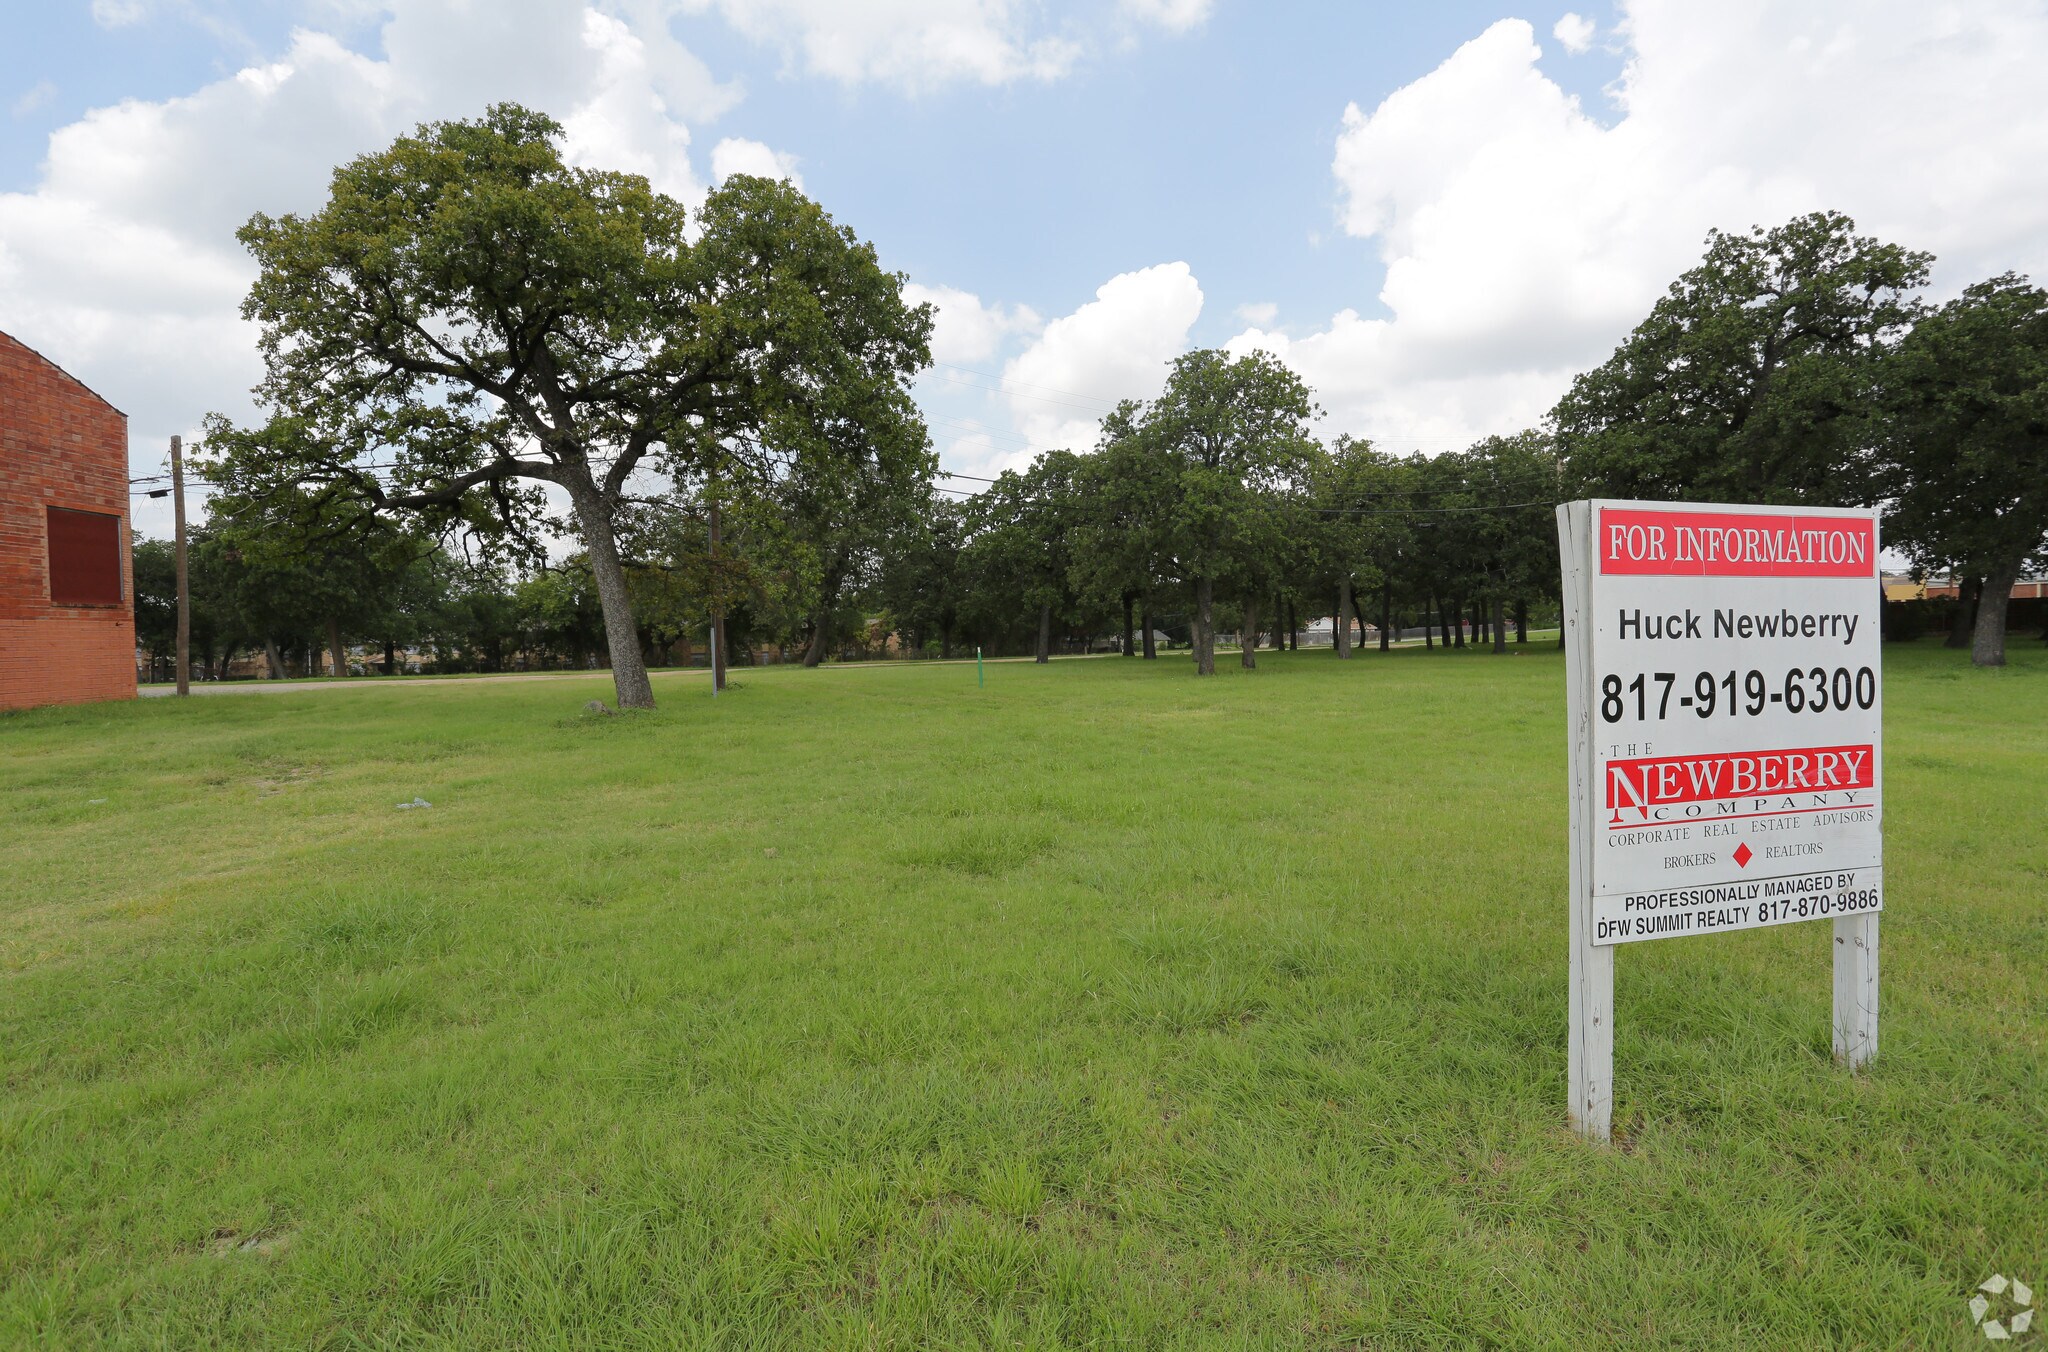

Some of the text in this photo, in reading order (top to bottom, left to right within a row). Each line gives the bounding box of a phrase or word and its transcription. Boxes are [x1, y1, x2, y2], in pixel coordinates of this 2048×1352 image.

[1608, 524, 1866, 564] FOR INFORMATION
[1620, 608, 1858, 645] Huck Newberry
[1602, 666, 1875, 723] 817-919-6300
[1611, 743, 1653, 757] THE
[1609, 750, 1867, 823] NEWBERRY
[1654, 792, 1859, 820] COMPANY
[1608, 810, 1874, 847] CORPORATE REAL ESTATE ADVISORS
[1664, 842, 1823, 869] BROKERS REALTORS
[1626, 874, 1855, 912] PROFESSIONALLY MANAGED BY
[1598, 889, 1878, 938] DFW SUMMIT REALTY 817-870-9886
